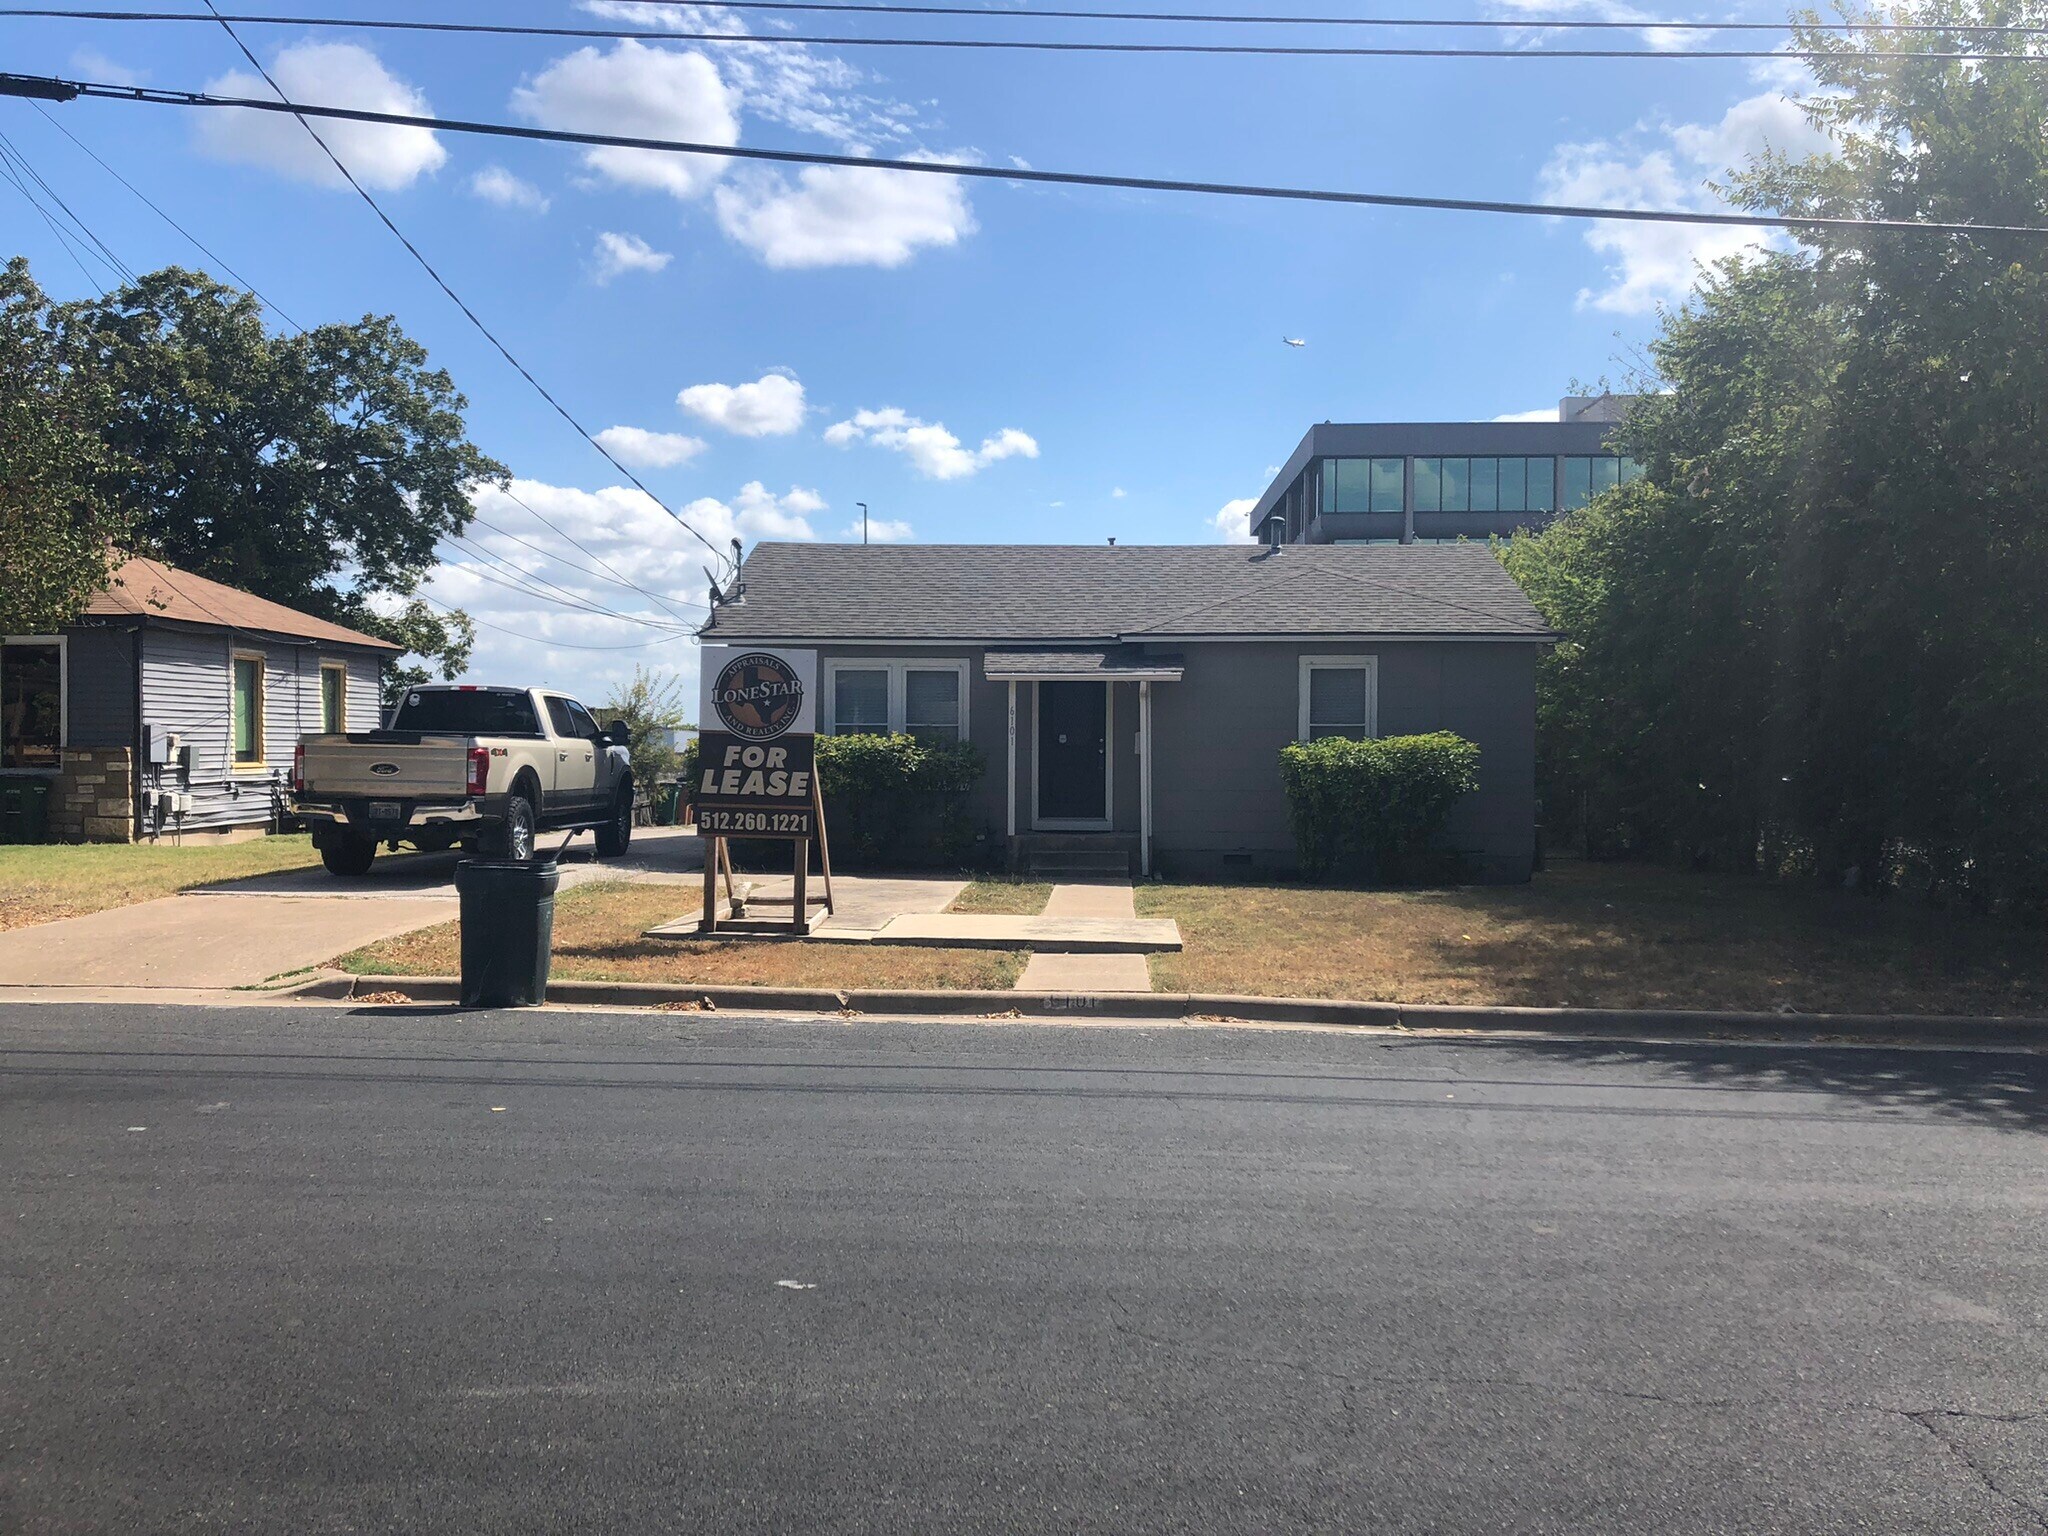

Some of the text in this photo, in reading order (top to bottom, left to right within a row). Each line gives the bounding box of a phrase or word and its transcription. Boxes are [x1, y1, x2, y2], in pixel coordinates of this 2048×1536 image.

[728, 657, 780, 677] APPRAISALS
[726, 714, 744, 731] AND
[723, 745, 788, 769] FOR
[700, 768, 810, 797] LEASE
[700, 811, 808, 832] 512.260.1221
